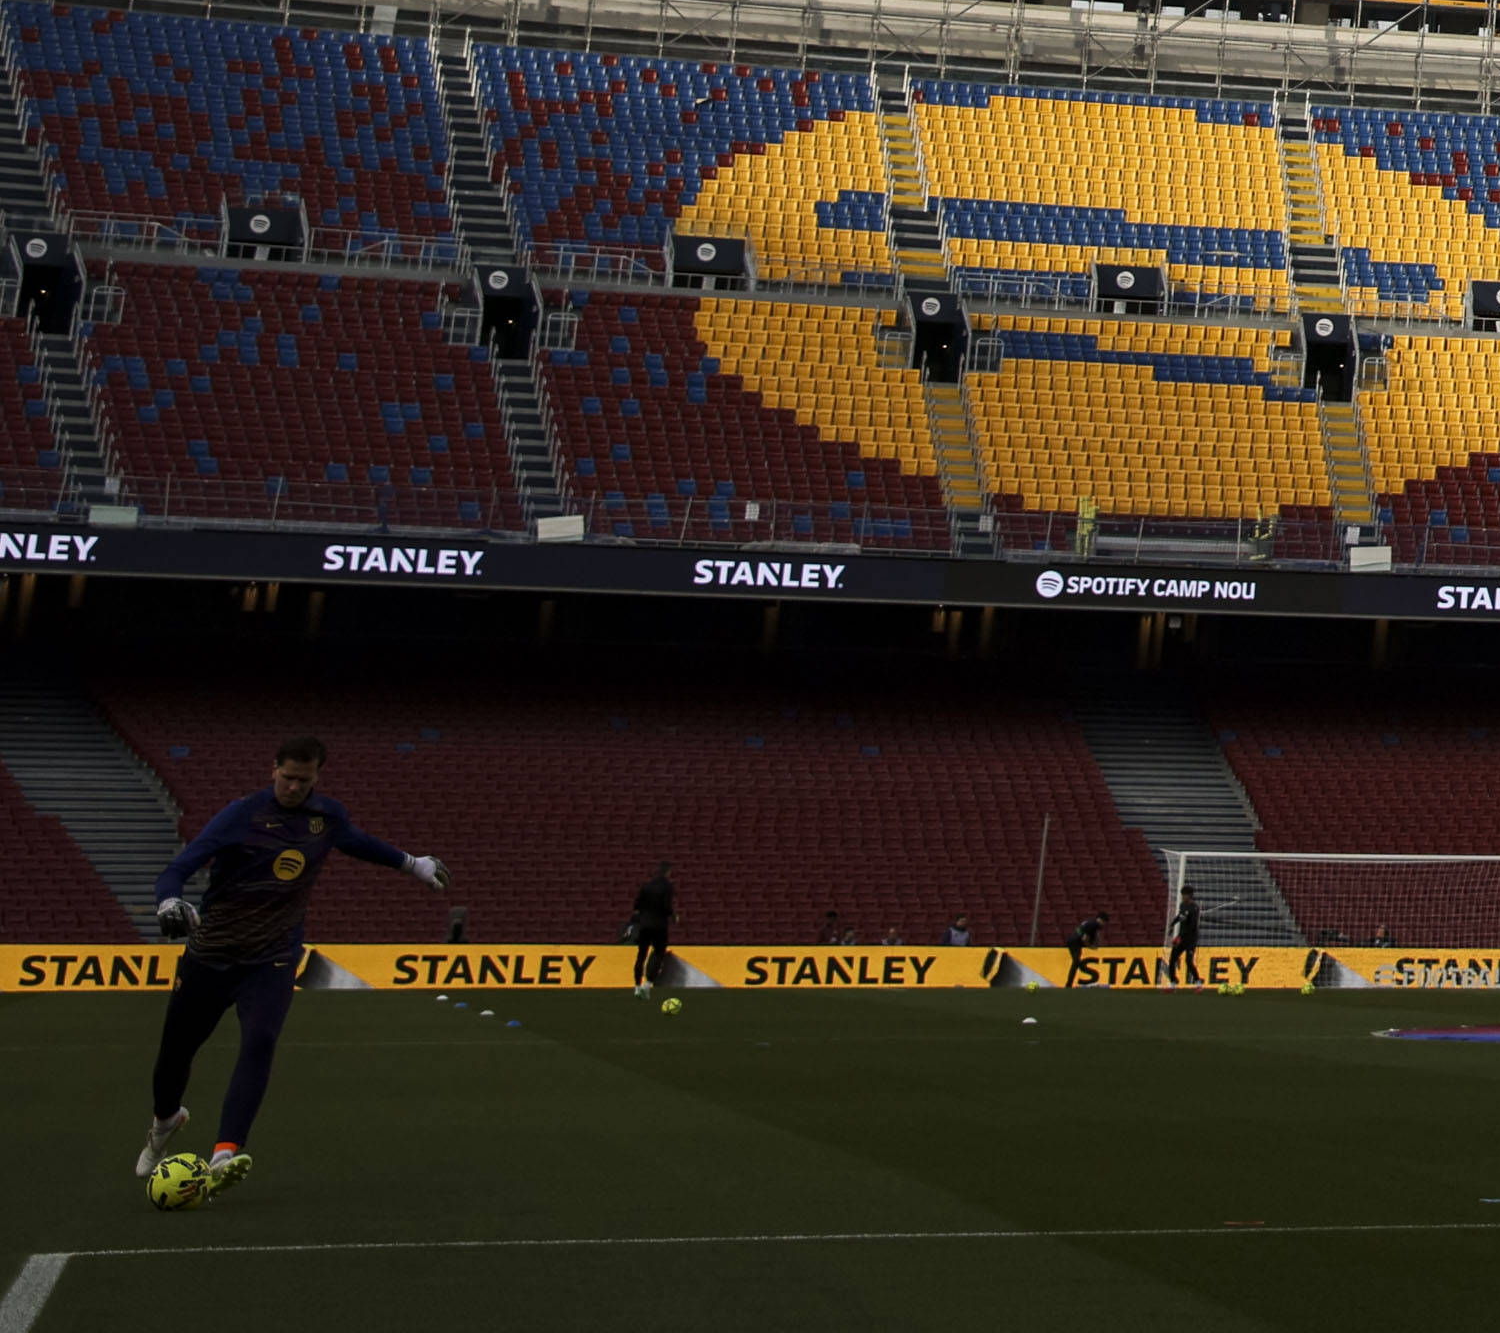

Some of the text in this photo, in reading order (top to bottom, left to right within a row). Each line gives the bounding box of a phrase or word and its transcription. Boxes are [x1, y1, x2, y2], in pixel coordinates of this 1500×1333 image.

[1066, 576, 1256, 600] SPOTIFY CAMP NOU
[18, 955, 170, 987] STANL
[392, 954, 596, 985] STANLEY
[744, 956, 936, 986] STANLEY
[1077, 956, 1259, 986] STAEY
